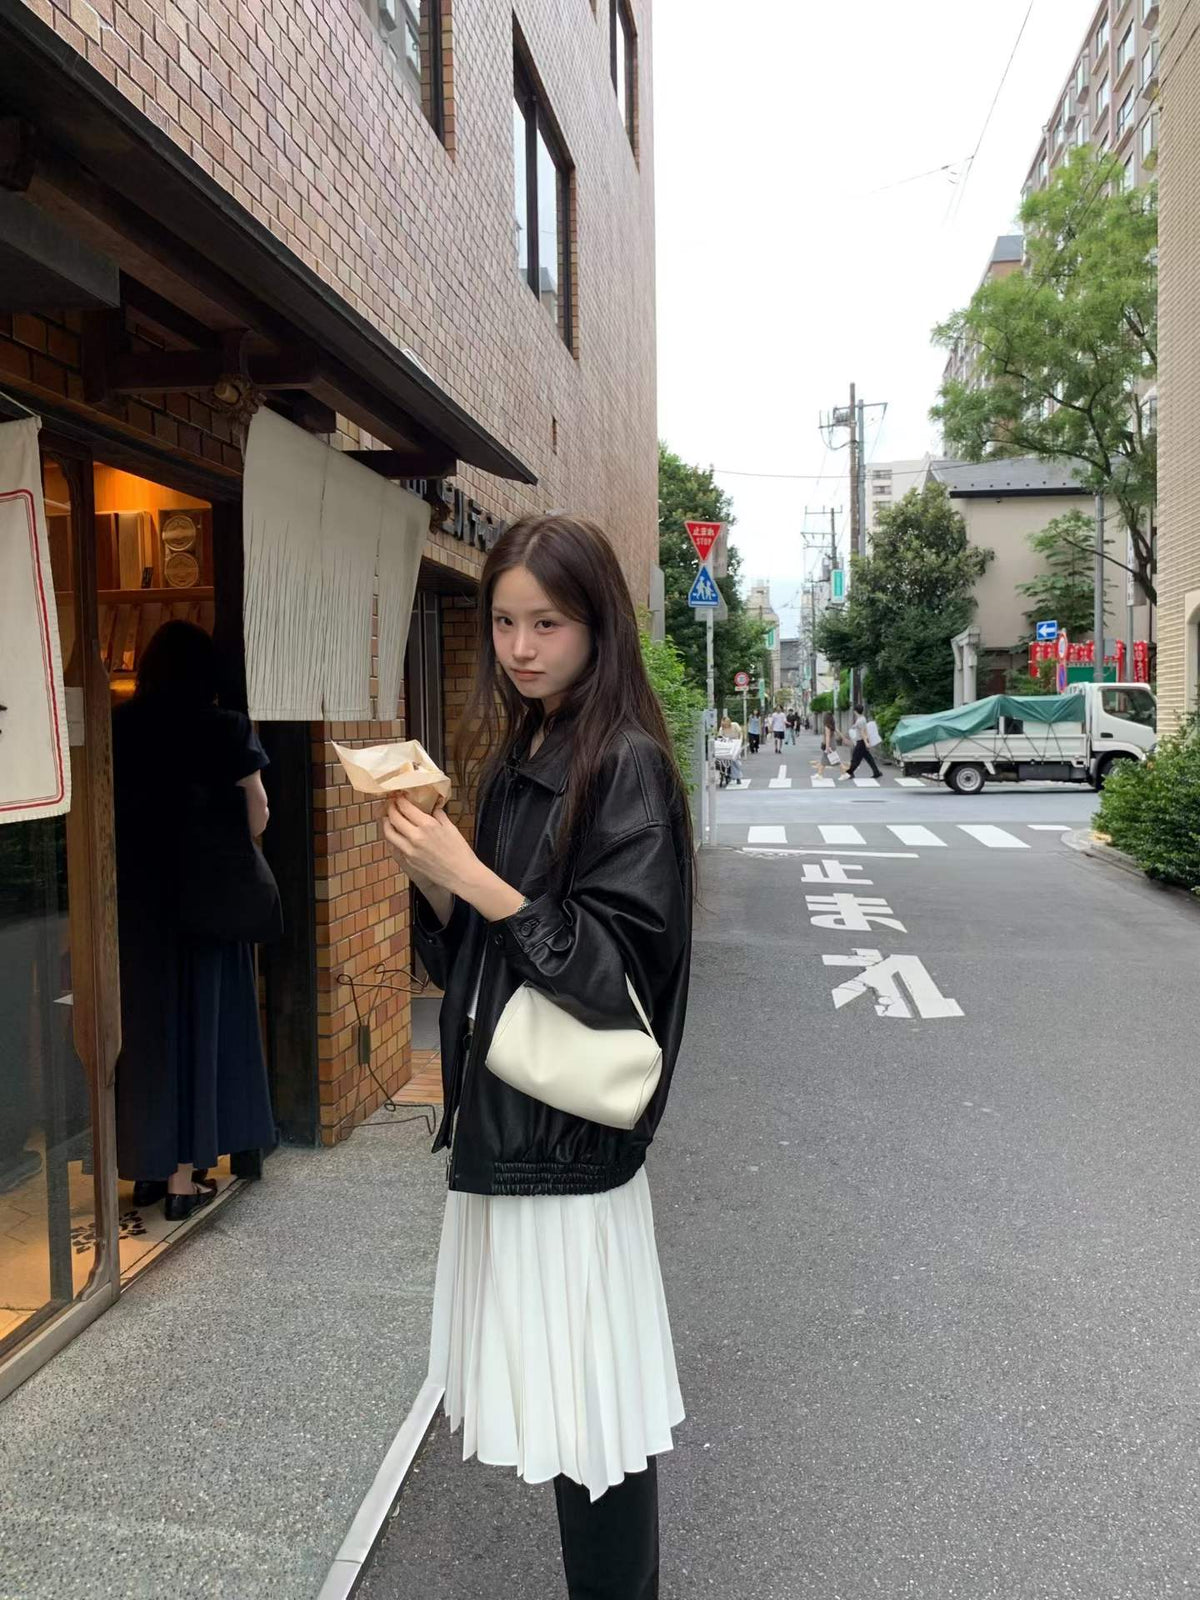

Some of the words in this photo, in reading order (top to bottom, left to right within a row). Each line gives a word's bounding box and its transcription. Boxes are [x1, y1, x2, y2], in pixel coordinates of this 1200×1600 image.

[692, 527, 714, 536] 止まれ
[696, 537, 712, 546] STOP
[800, 859, 966, 1019] 止まれ
